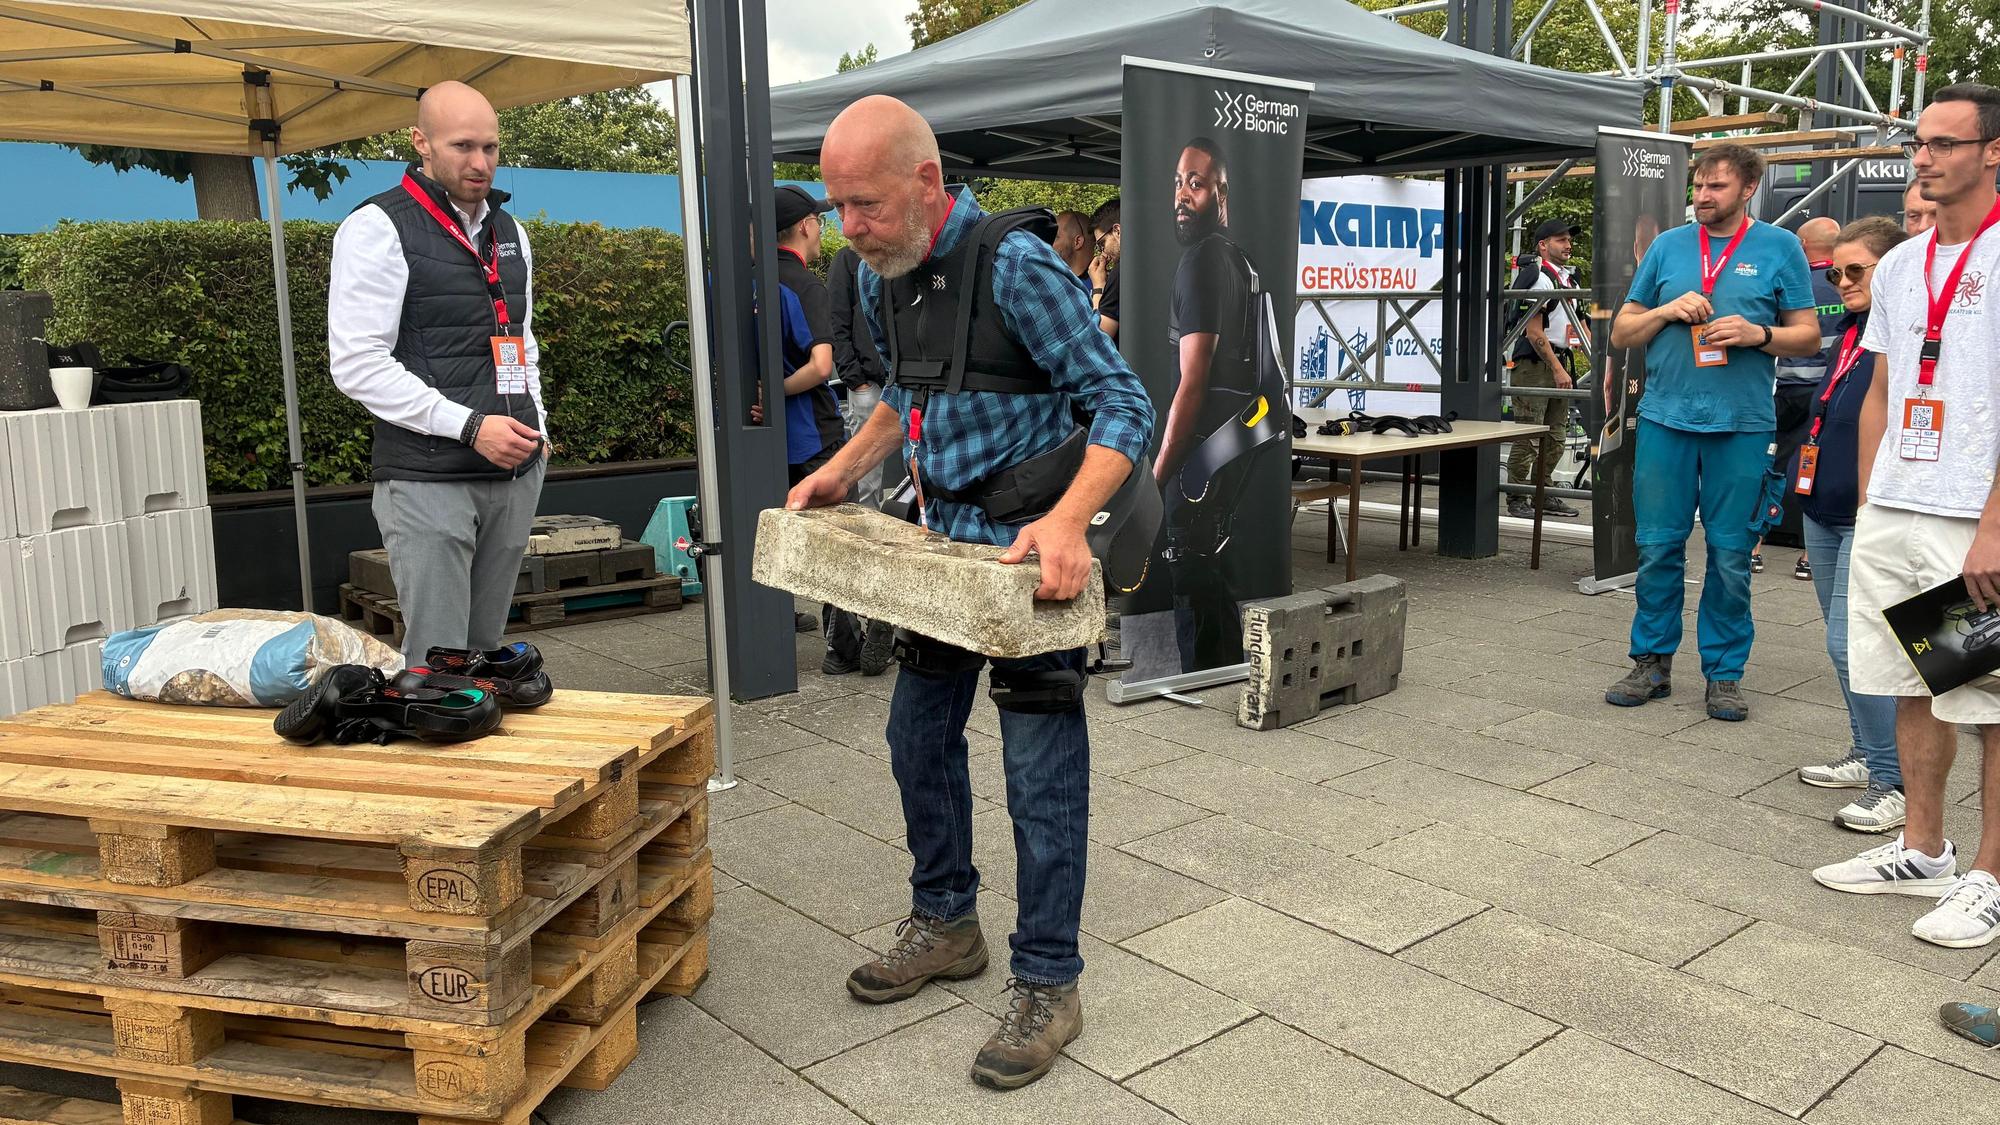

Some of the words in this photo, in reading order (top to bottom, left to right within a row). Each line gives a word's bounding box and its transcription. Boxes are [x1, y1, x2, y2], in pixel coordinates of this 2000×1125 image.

[1244, 94, 1299, 117] German
[1244, 112, 1288, 135] Bionic
[1640, 148, 1671, 165] German
[1640, 163, 1665, 179] Bionic
[1301, 262, 1417, 290] GERÜSTBAU
[426, 877, 471, 902] EPAL
[131, 933, 155, 943] ES-08
[431, 971, 468, 998] EUR
[426, 1067, 467, 1092] EPAL
